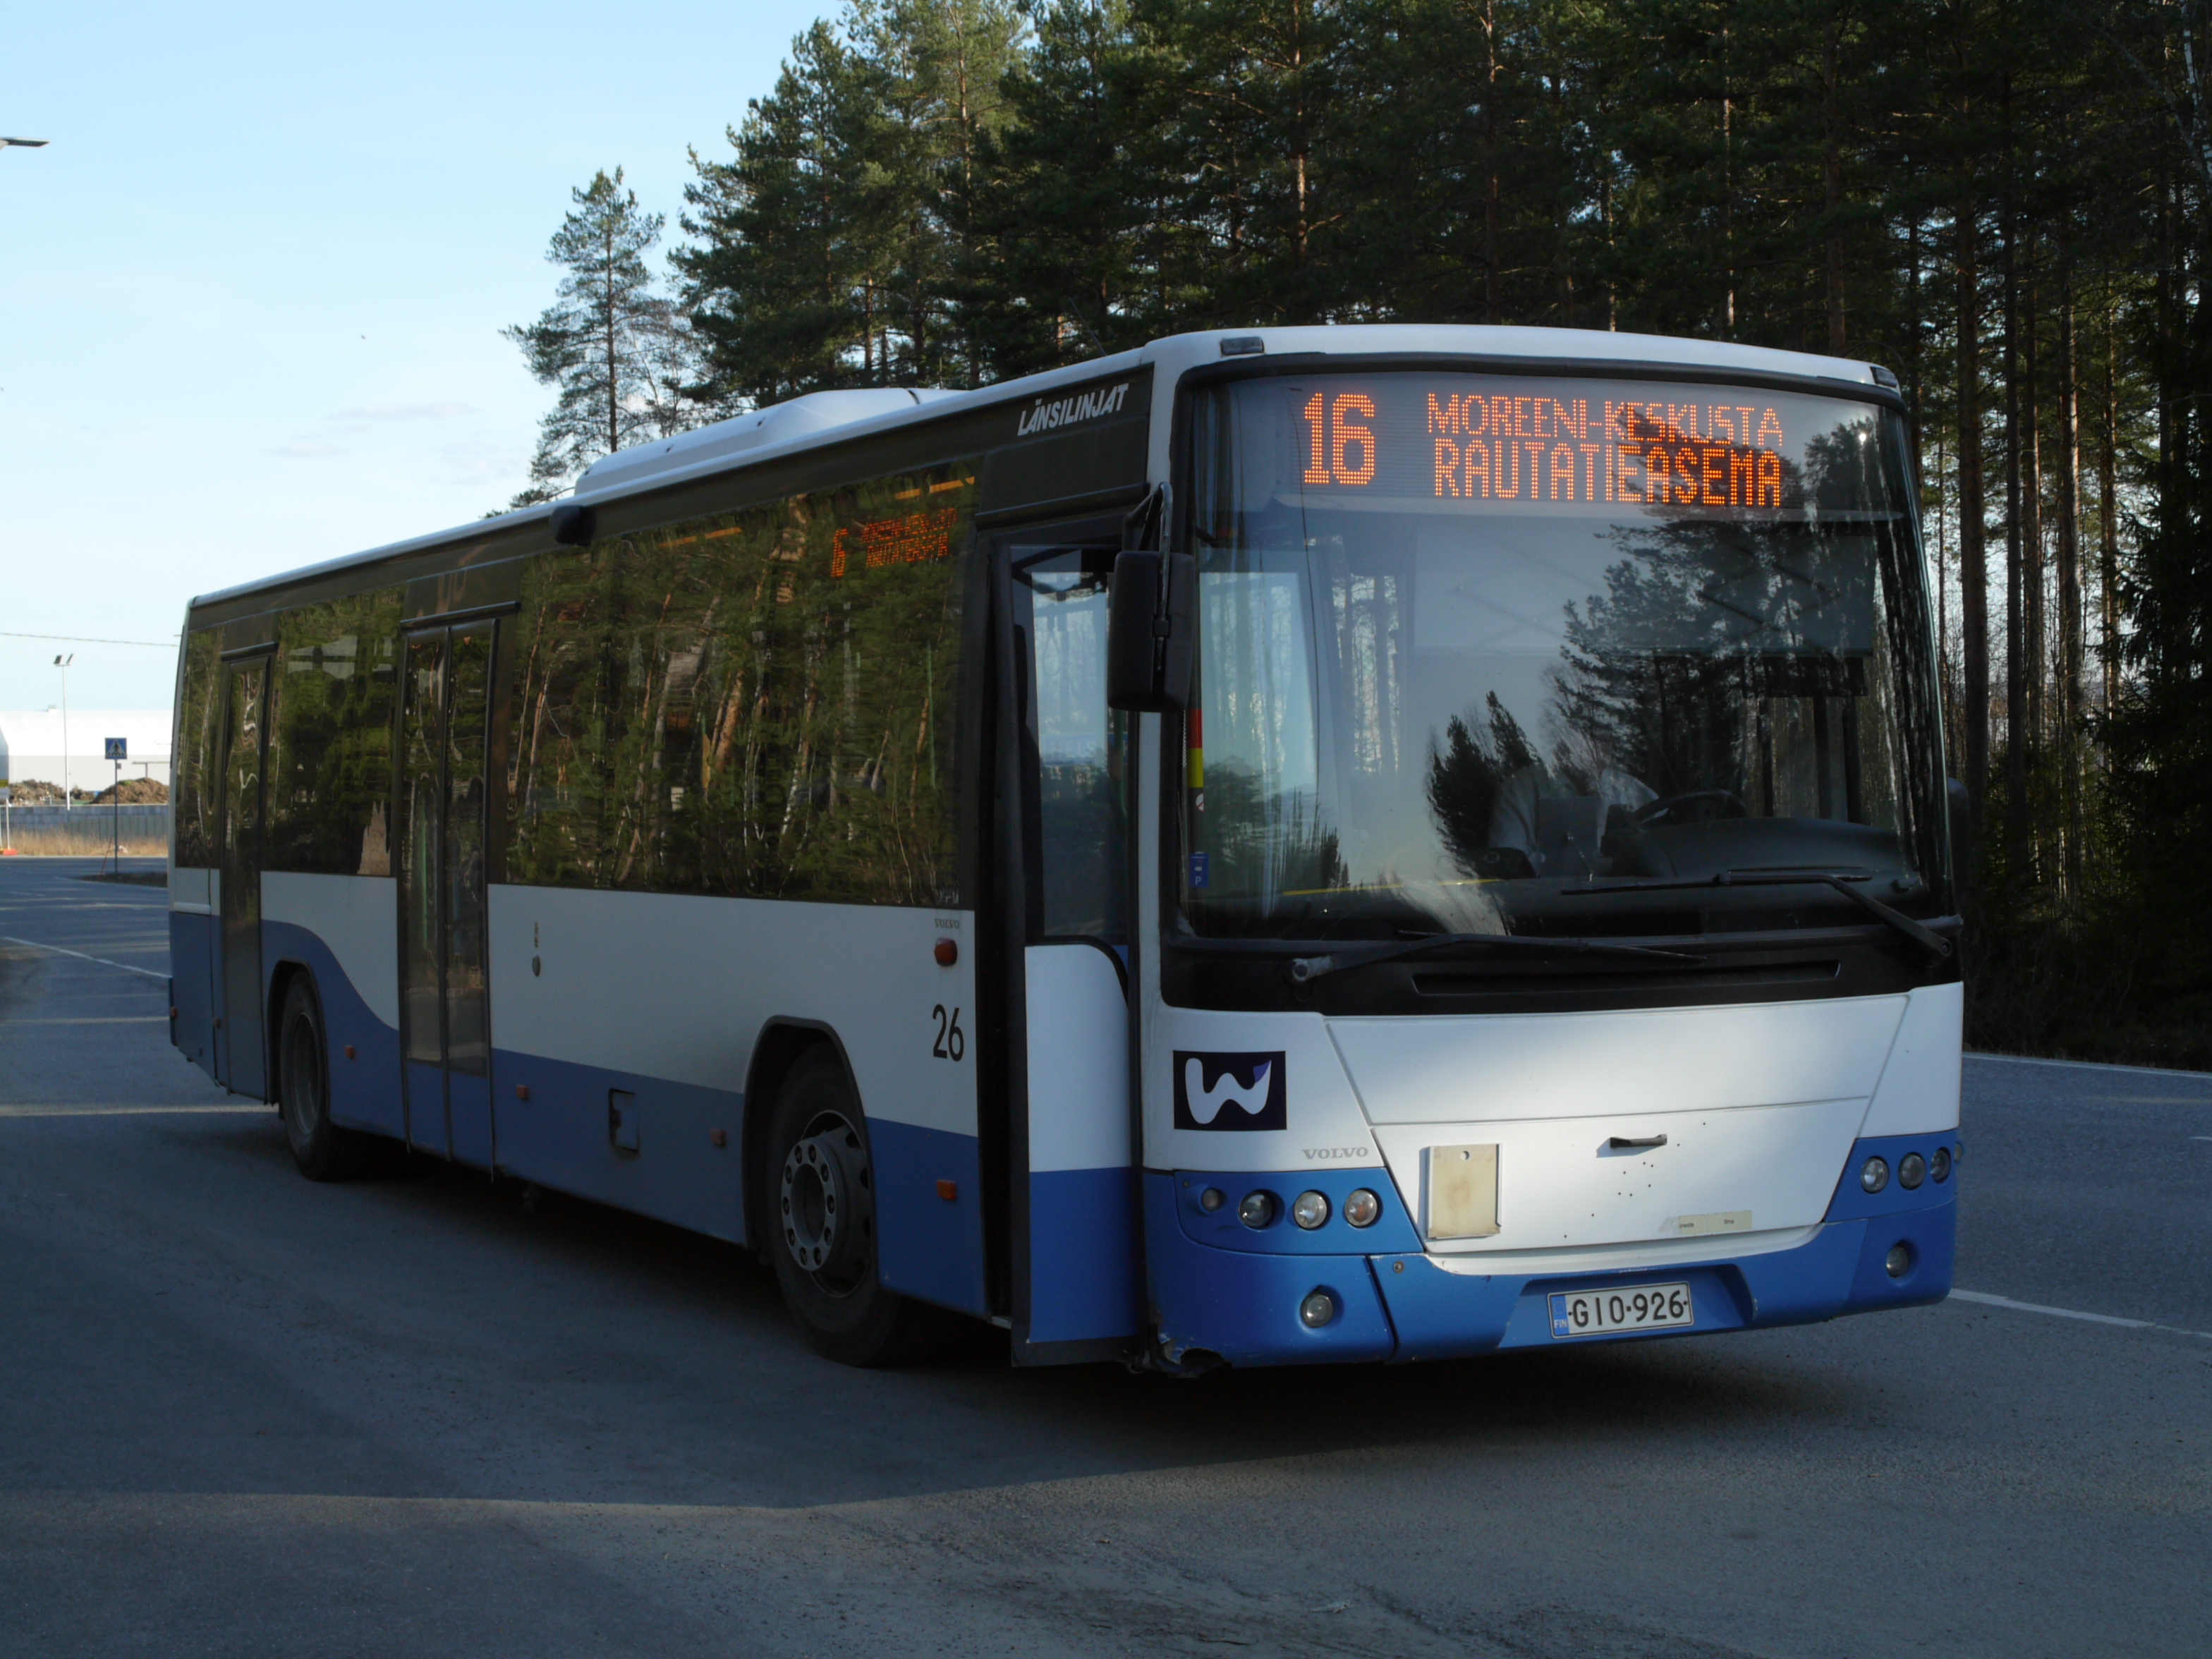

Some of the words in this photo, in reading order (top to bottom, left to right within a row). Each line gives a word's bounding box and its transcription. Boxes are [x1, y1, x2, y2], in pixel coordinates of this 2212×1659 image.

[1017, 383, 1129, 436] LÄNSILINJAT
[1428, 393, 1782, 447] MOREENI-KESKUSTA
[1304, 392, 1375, 484] 16
[1435, 438, 1780, 506] RAUTATIEASEMA
[935, 918, 960, 930] VOLVO
[932, 1004, 964, 1062] 26
[1301, 1146, 1368, 1160] VOLVO
[1554, 1319, 1568, 1328] FIN
[1572, 1290, 1684, 1327] GIO-926
